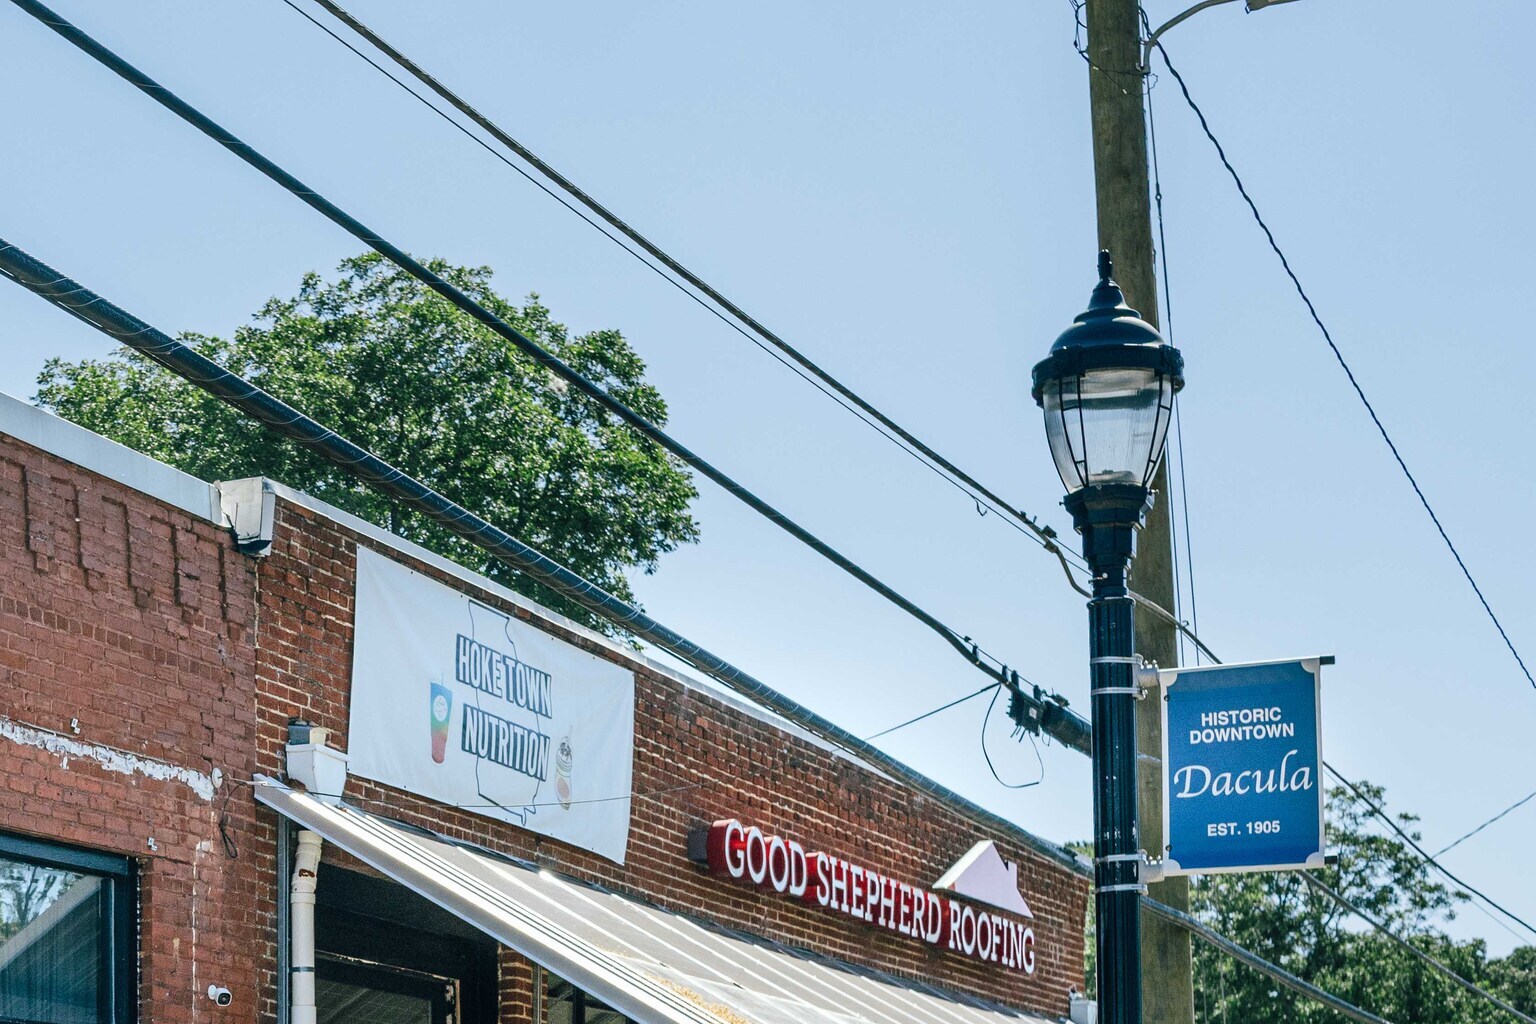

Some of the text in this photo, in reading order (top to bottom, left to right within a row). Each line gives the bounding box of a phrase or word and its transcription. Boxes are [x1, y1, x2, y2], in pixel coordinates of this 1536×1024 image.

[456, 633, 553, 720] HOKE TOWN
[461, 703, 551, 782] NUTRITION
[1189, 723, 1295, 745] DOWNTOWN
[1201, 707, 1282, 728] HISTORIC
[1173, 749, 1313, 799] Dacula
[1207, 820, 1281, 838] EST. 1905
[724, 818, 1036, 975] GOOD SHEPHERD ROOFING
